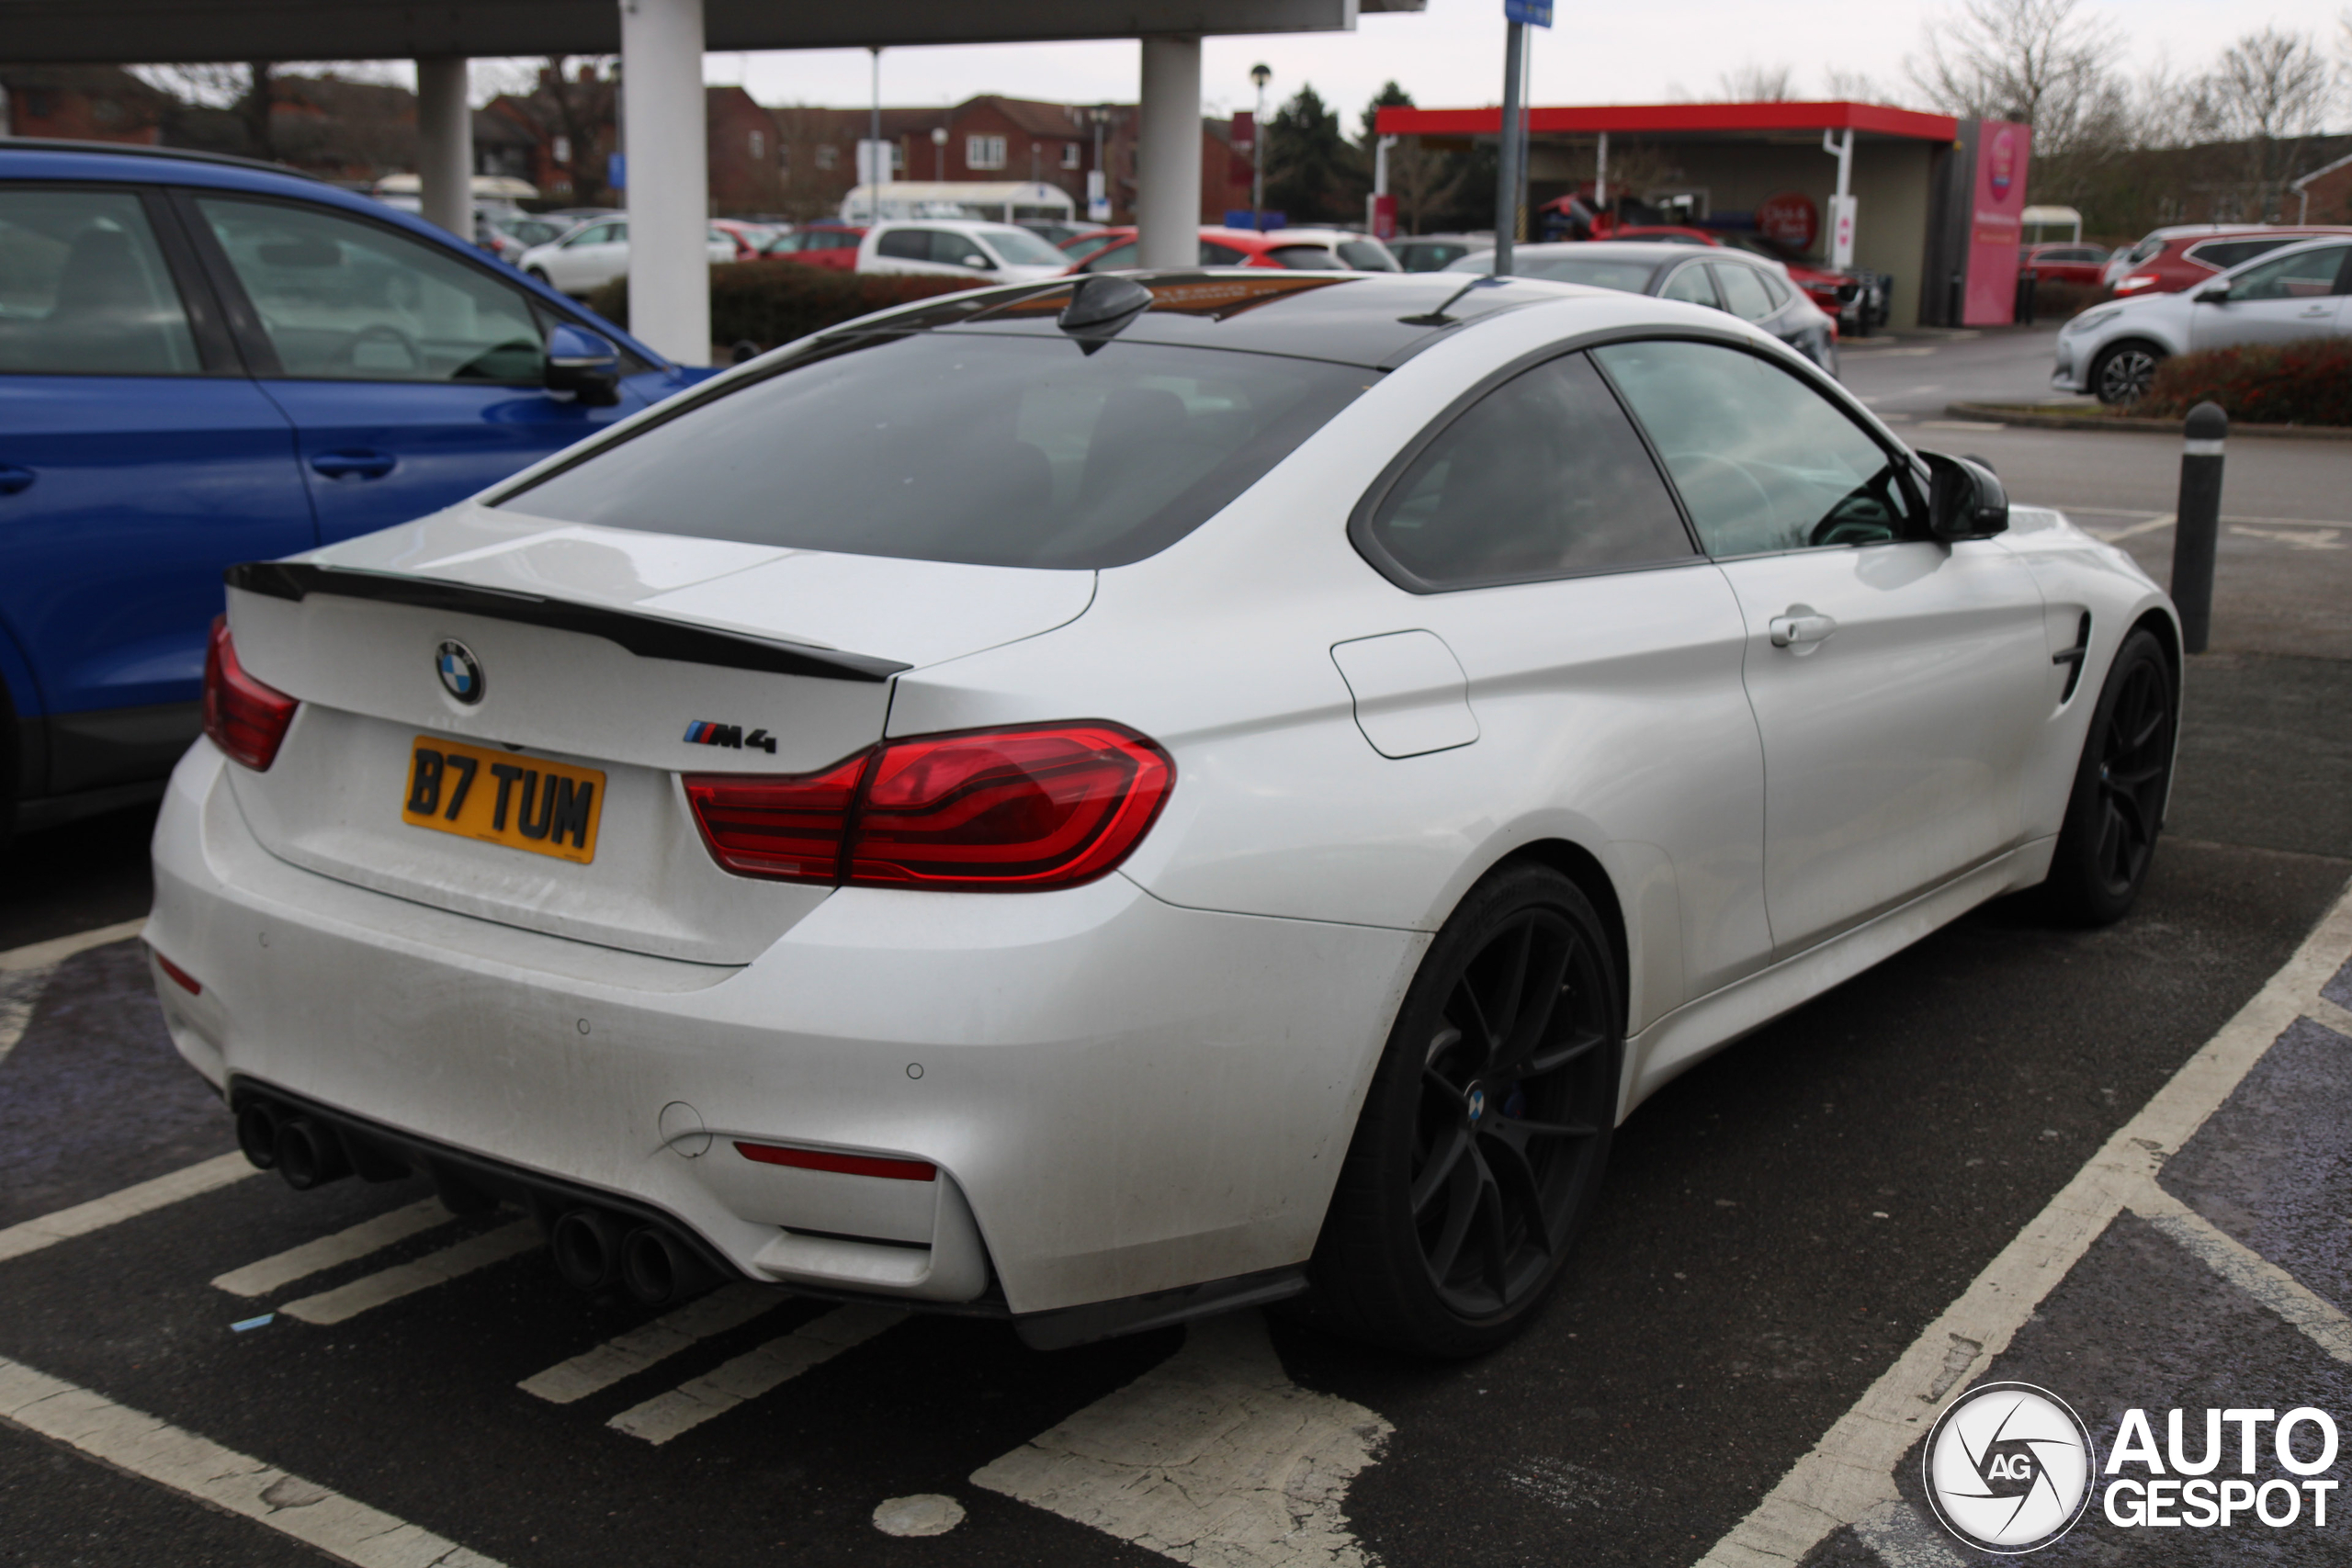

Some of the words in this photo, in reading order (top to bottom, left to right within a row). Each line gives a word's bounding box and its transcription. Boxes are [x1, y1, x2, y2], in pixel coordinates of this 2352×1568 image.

[705, 723, 776, 753] M4
[407, 747, 478, 821] B7
[491, 762, 594, 849] TUM
